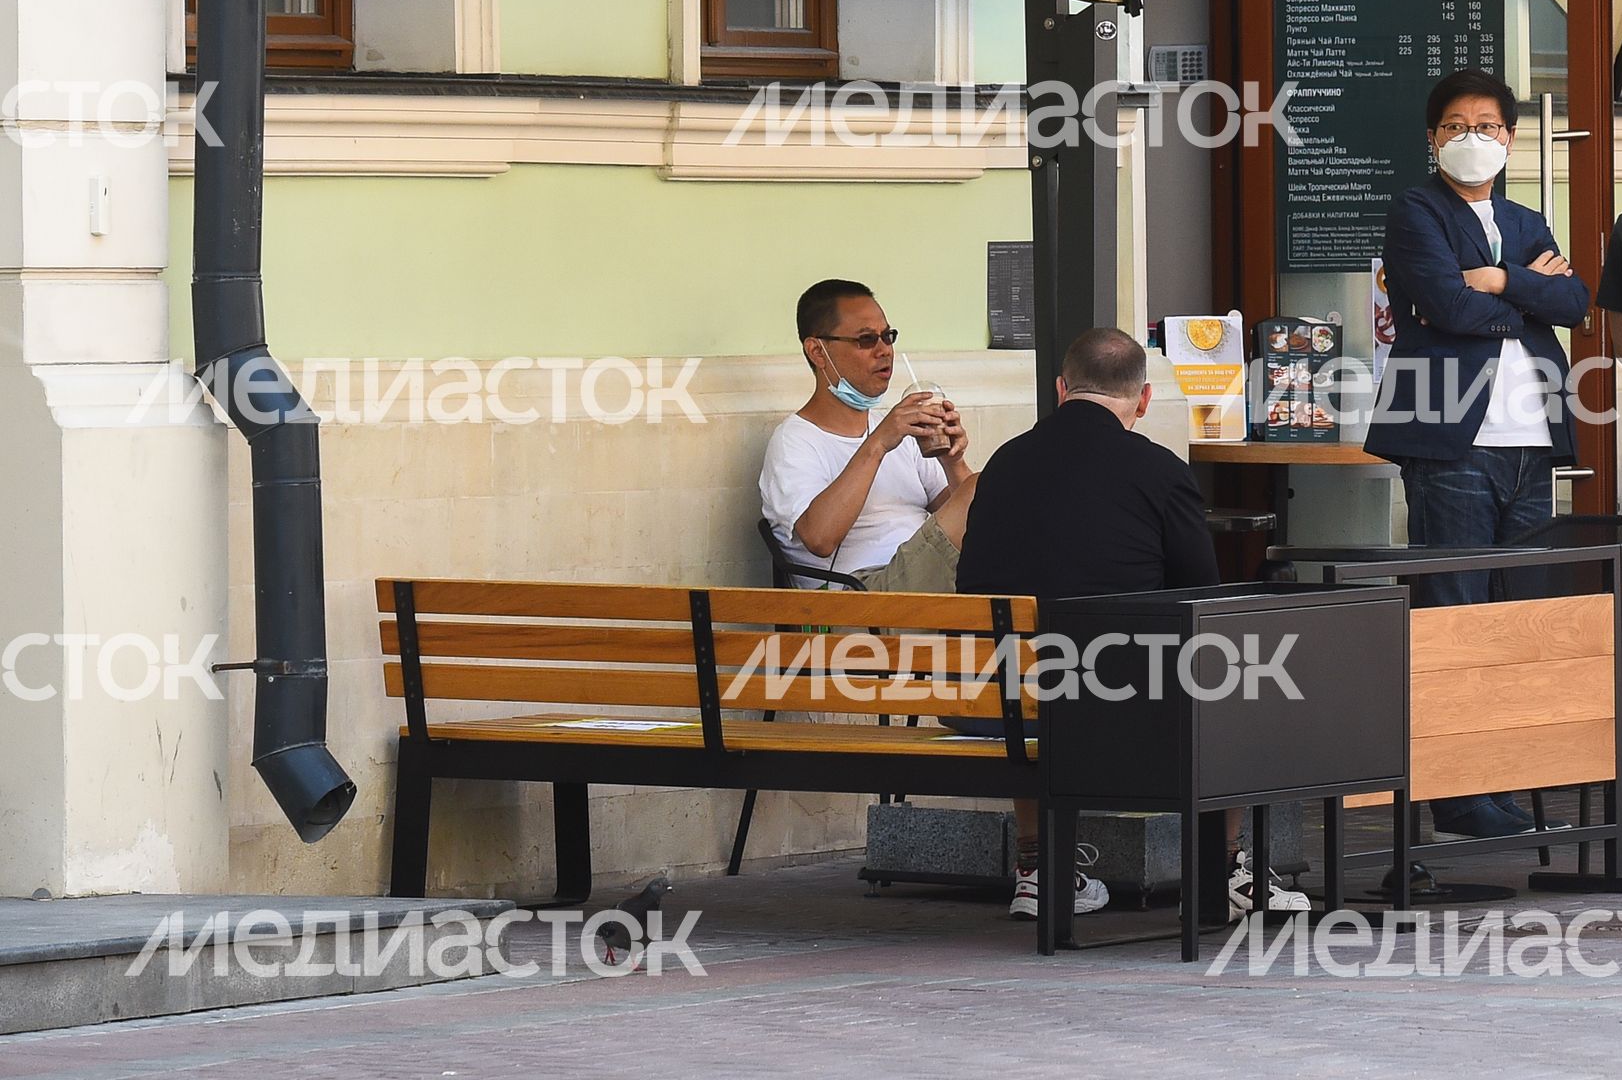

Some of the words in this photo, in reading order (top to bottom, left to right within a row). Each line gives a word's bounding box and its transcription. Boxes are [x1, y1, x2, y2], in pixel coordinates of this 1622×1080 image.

[1286, 5, 1319, 13] Эспрессо
[1442, 2, 1455, 10] 145
[1468, 2, 1481, 10] 160
[1286, 15, 1319, 23] Эспрессо
[1336, 14, 1357, 22] Панна
[1442, 12, 1455, 20] 145
[1468, 12, 1481, 20] 160
[1287, 25, 1307, 34] Лунго
[1287, 37, 1316, 46] Пряный
[1399, 35, 1412, 43] 225
[1427, 35, 1440, 43] 295
[1480, 34, 1493, 42] 335
[1311, 48, 1323, 56] Чай
[1325, 48, 1346, 56] Латте
[1399, 47, 1412, 55] 225
[1427, 47, 1440, 55] 295
[1454, 46, 1467, 54] 310
[1480, 46, 1493, 54] 335
[1287, 59, 1310, 67] Айс-Ти
[1312, 59, 1344, 67] Лимонад
[1427, 57, 1440, 65] 235
[1480, 56, 1493, 64] 265
[1287, 70, 1337, 78] Охлаждённый
[1427, 68, 1440, 76] 230
[1288, 105, 1335, 113] Классический
[1288, 115, 1320, 124] Эспрессо
[1288, 136, 1334, 144] Карамельный
[1288, 147, 1333, 155] Шоколадный
[1288, 157, 1324, 165] Ванильный
[1329, 157, 1371, 165] Шоколадный
[1308, 183, 1349, 191] Тропический
[1288, 194, 1320, 202] Лимонад
